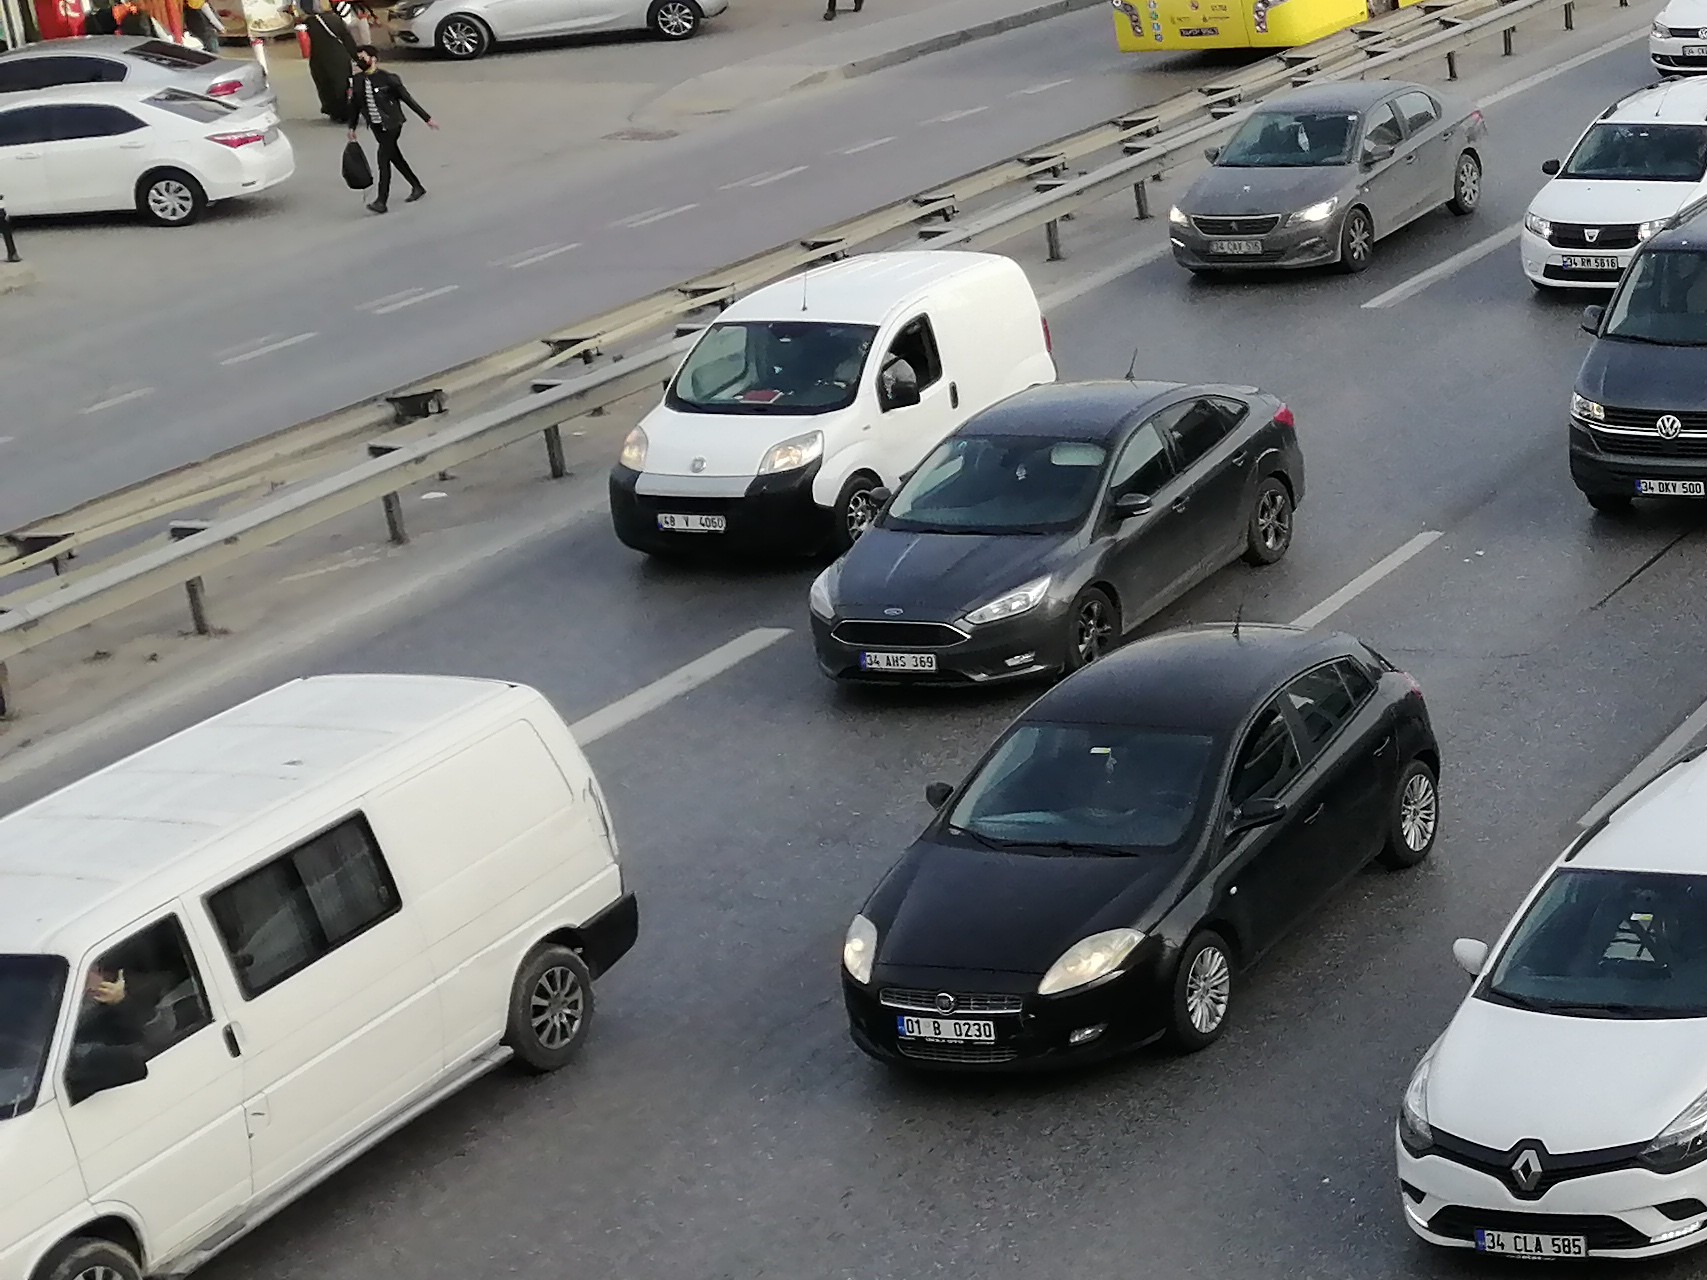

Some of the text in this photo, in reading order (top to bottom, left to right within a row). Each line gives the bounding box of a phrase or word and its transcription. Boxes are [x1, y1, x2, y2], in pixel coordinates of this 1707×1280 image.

[1567, 257, 1578, 267] 34
[1641, 481, 1654, 492] 34
[1682, 483, 1702, 494] 500
[664, 514, 675, 526] 48
[699, 516, 724, 529] 4060
[867, 654, 934, 669] 34 AHS 369
[906, 1018, 993, 1038] 01 B 0230
[1486, 1231, 1582, 1255] 34 CLA 585
